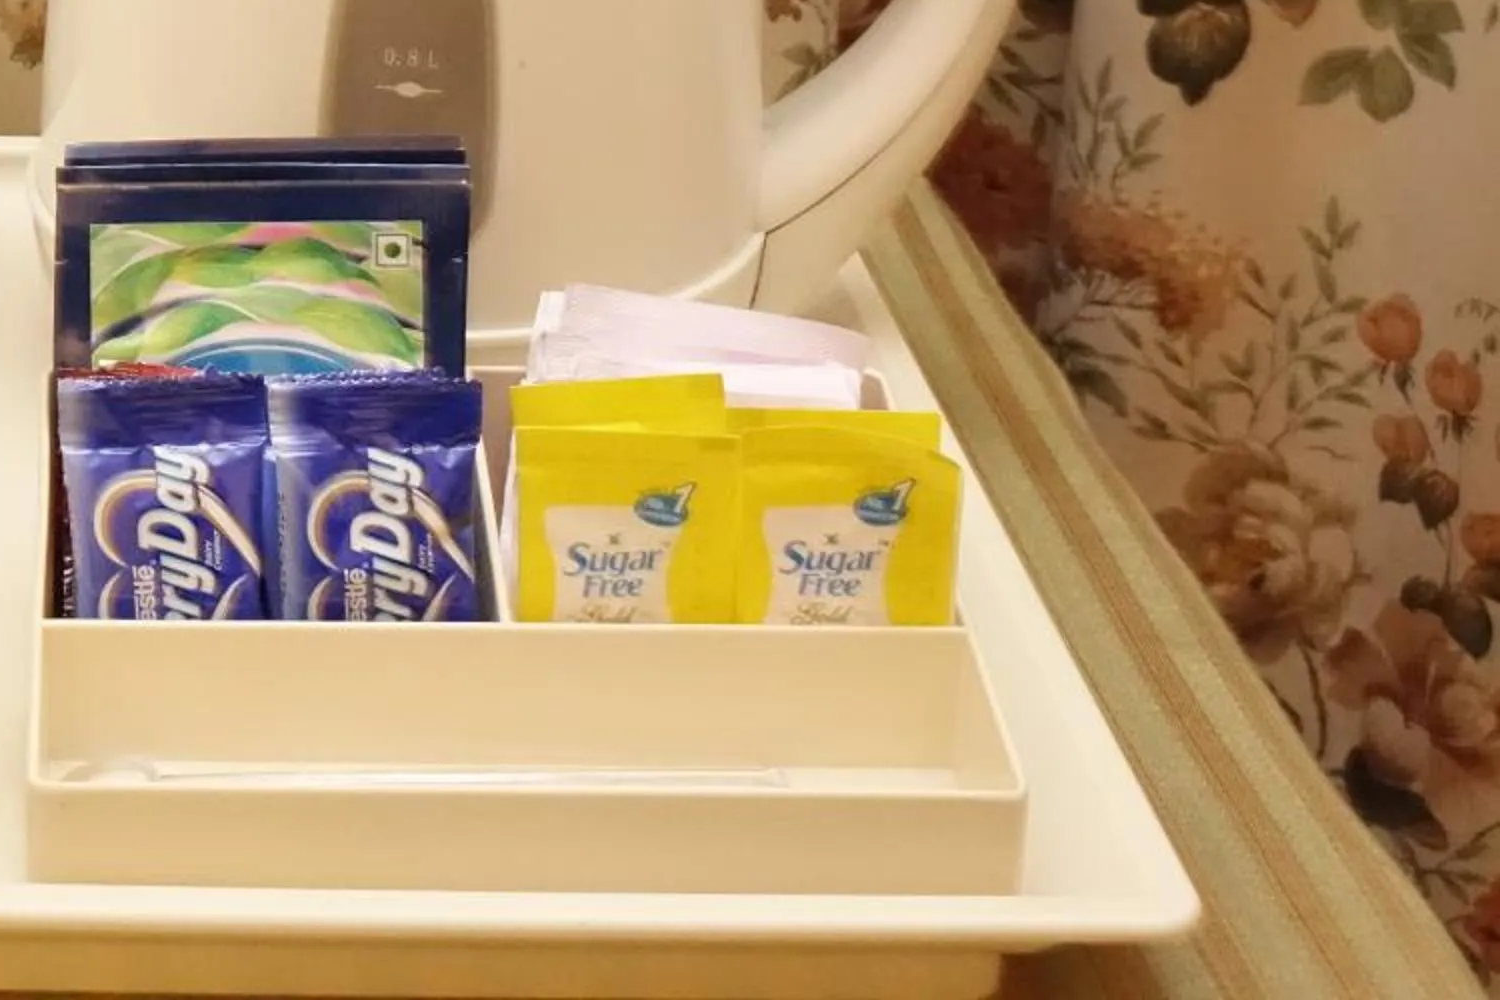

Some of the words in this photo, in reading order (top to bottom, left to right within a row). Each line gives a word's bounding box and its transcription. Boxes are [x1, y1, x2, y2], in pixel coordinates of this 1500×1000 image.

[350, 447, 425, 621] ryDay
[563, 541, 664, 577] Sugar
[778, 540, 882, 576] Sugar
[582, 574, 644, 598] Free
[798, 573, 862, 597] Free
